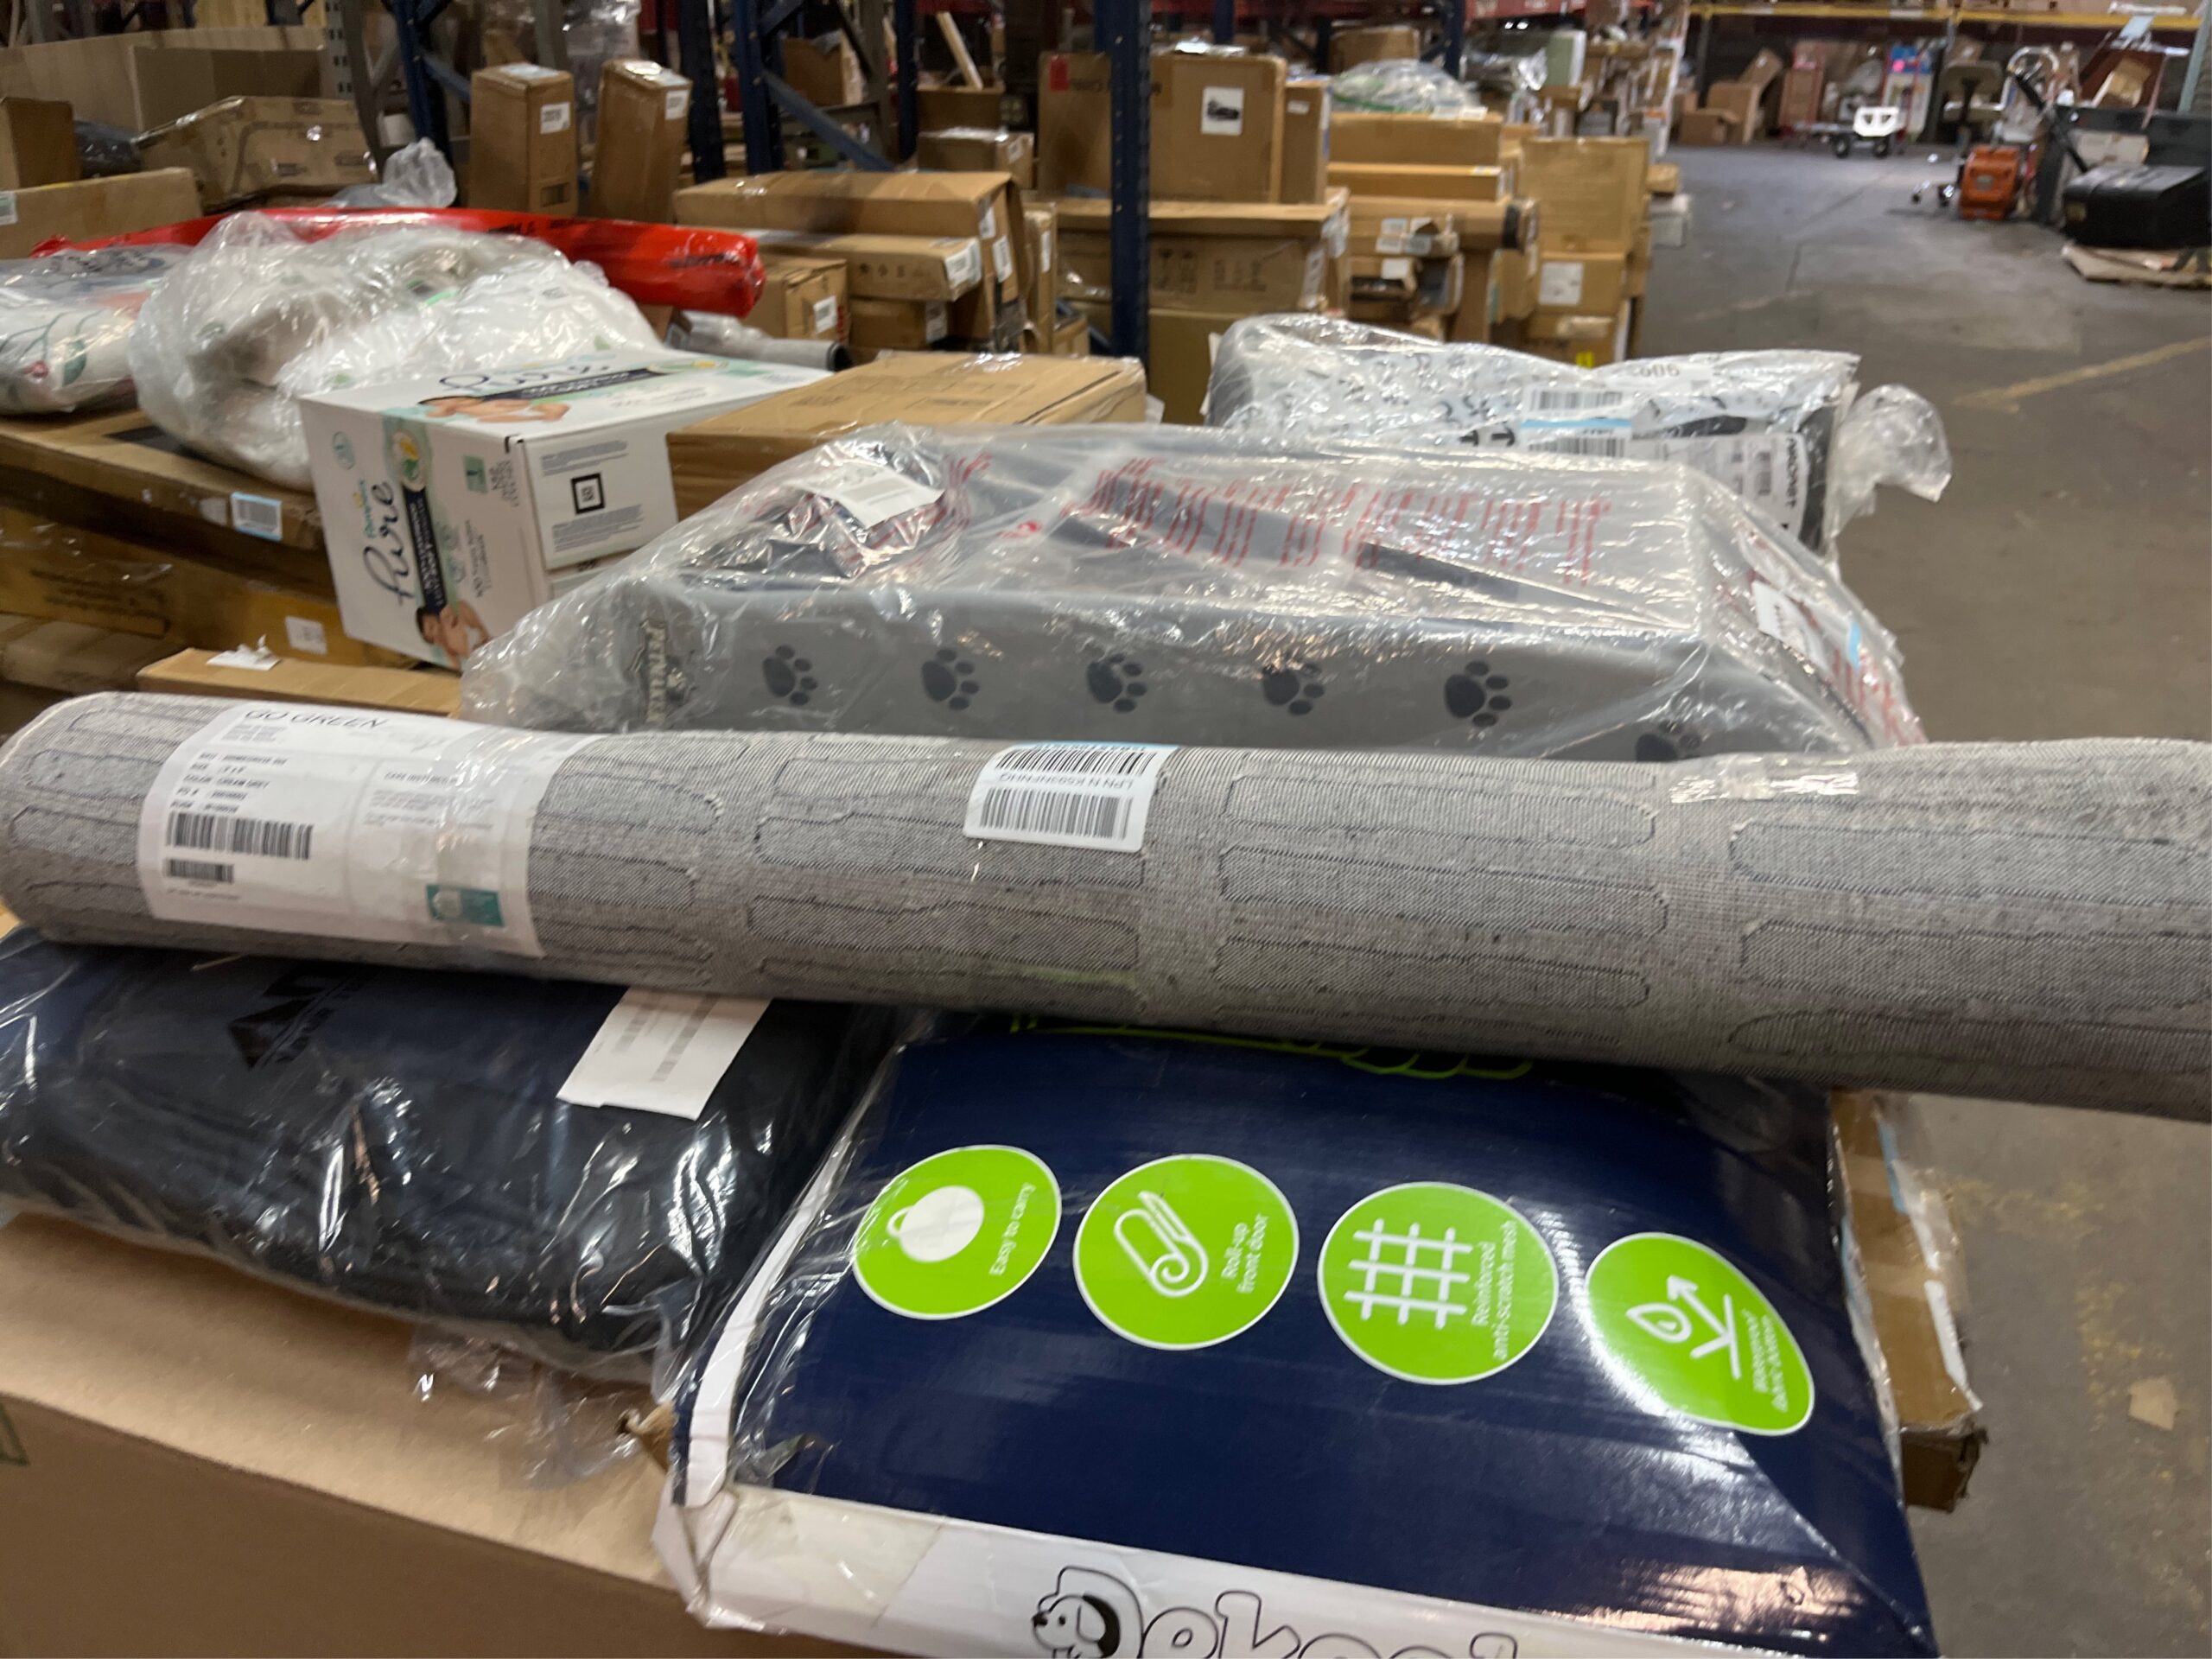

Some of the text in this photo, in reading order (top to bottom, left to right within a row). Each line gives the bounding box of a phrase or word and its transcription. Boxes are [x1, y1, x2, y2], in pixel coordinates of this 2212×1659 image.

[988, 1183, 1036, 1275] Easy to carry
[1236, 1212, 1269, 1293] front door
[1471, 1241, 1497, 1325] Reinforced
